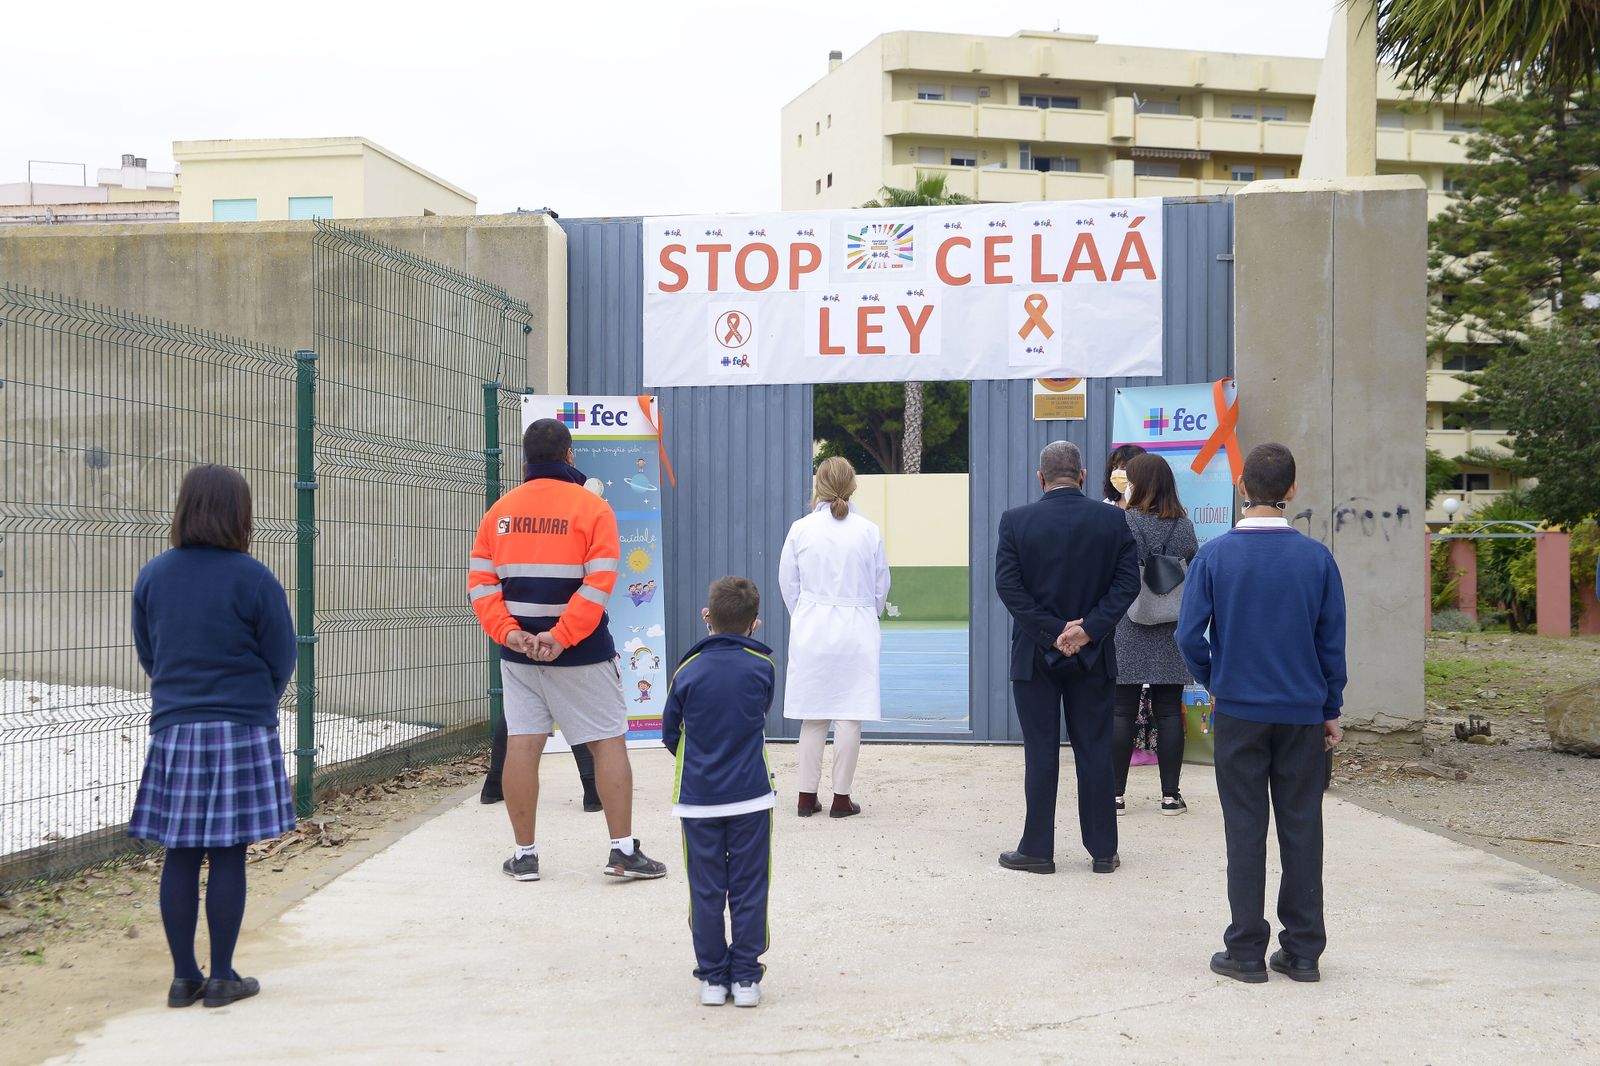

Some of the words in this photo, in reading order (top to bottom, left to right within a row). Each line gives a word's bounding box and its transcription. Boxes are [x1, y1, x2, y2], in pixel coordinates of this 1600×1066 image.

[658, 242, 823, 293] STOP
[935, 216, 1157, 286] CELAÁ
[819, 304, 934, 356] LEY
[590, 403, 628, 426] fec
[1173, 408, 1208, 432] fec
[1193, 503, 1229, 524] CUÍDALE!
[513, 516, 568, 536] KALMAR
